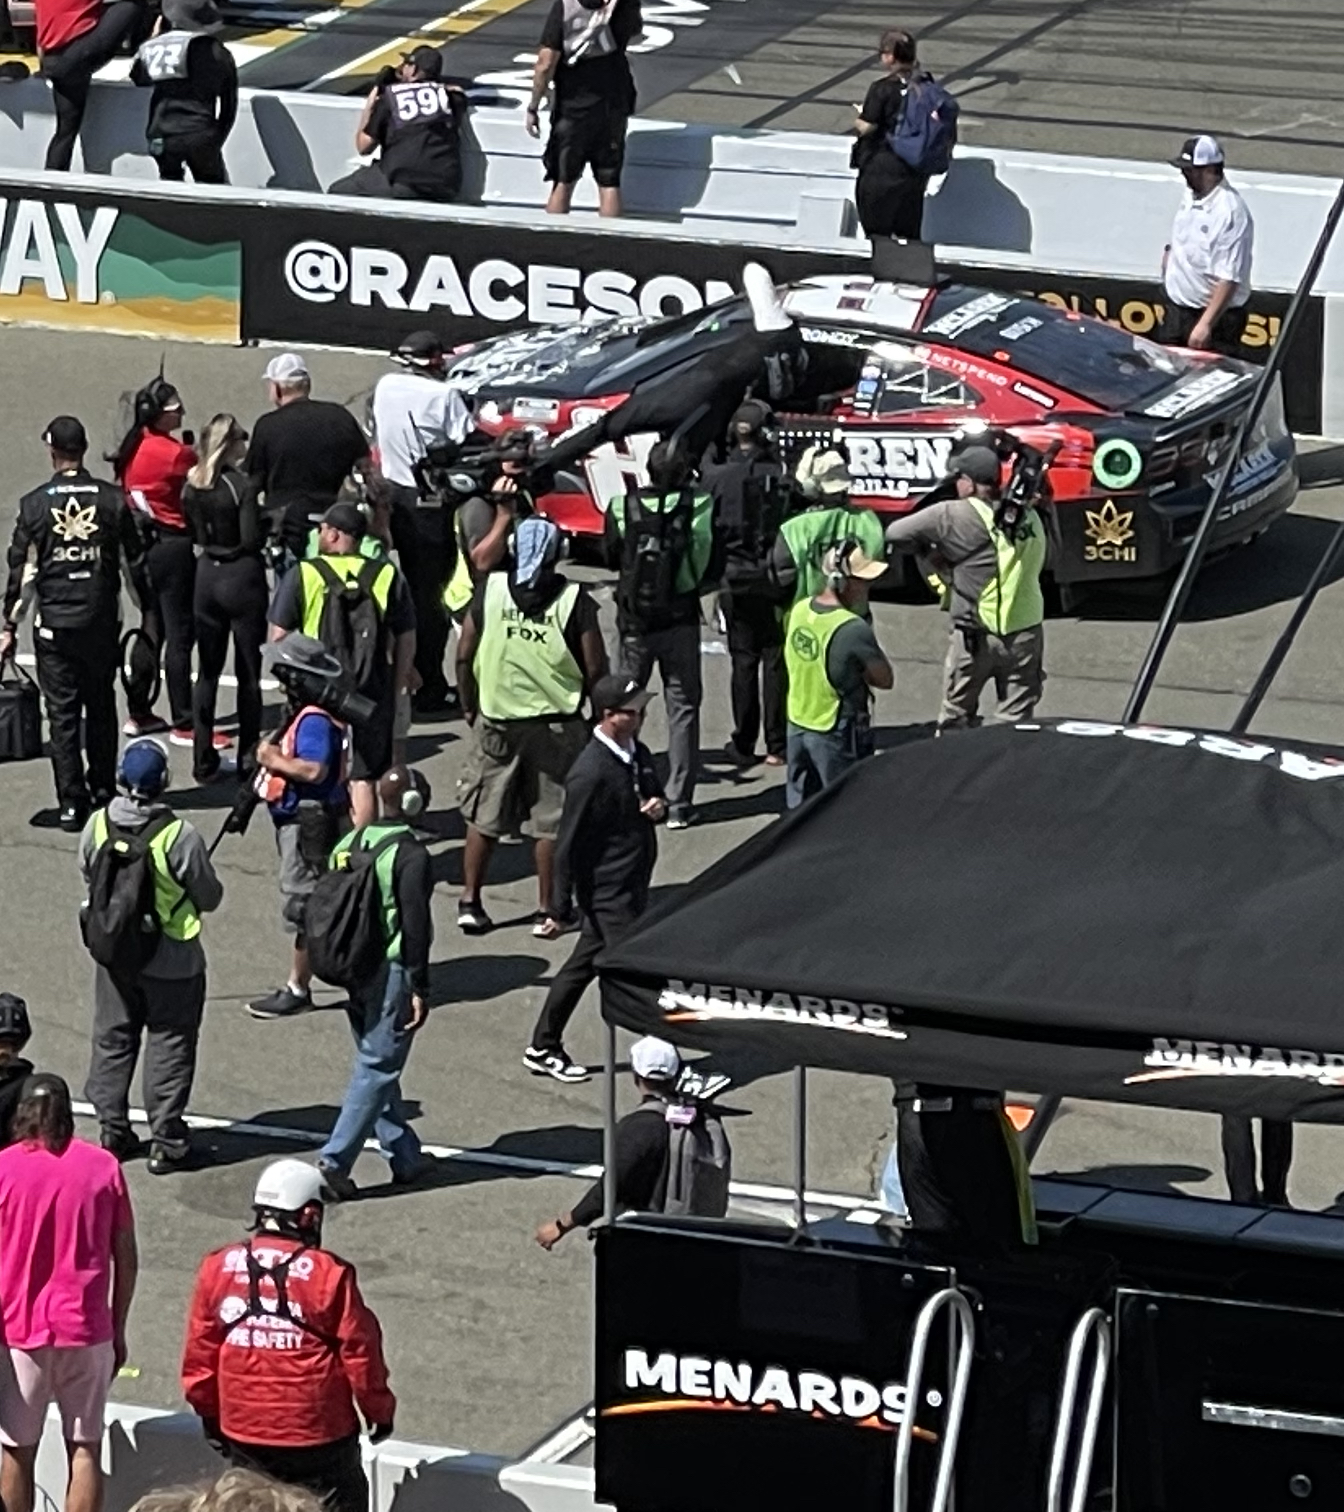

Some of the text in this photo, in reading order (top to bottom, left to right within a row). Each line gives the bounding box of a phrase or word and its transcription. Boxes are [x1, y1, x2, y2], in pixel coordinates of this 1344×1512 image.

[1084, 545, 1137, 563] 3CHI
[507, 626, 548, 645] FOX
[657, 978, 896, 1031] MENARDS
[624, 1348, 911, 1424] MENARDS
